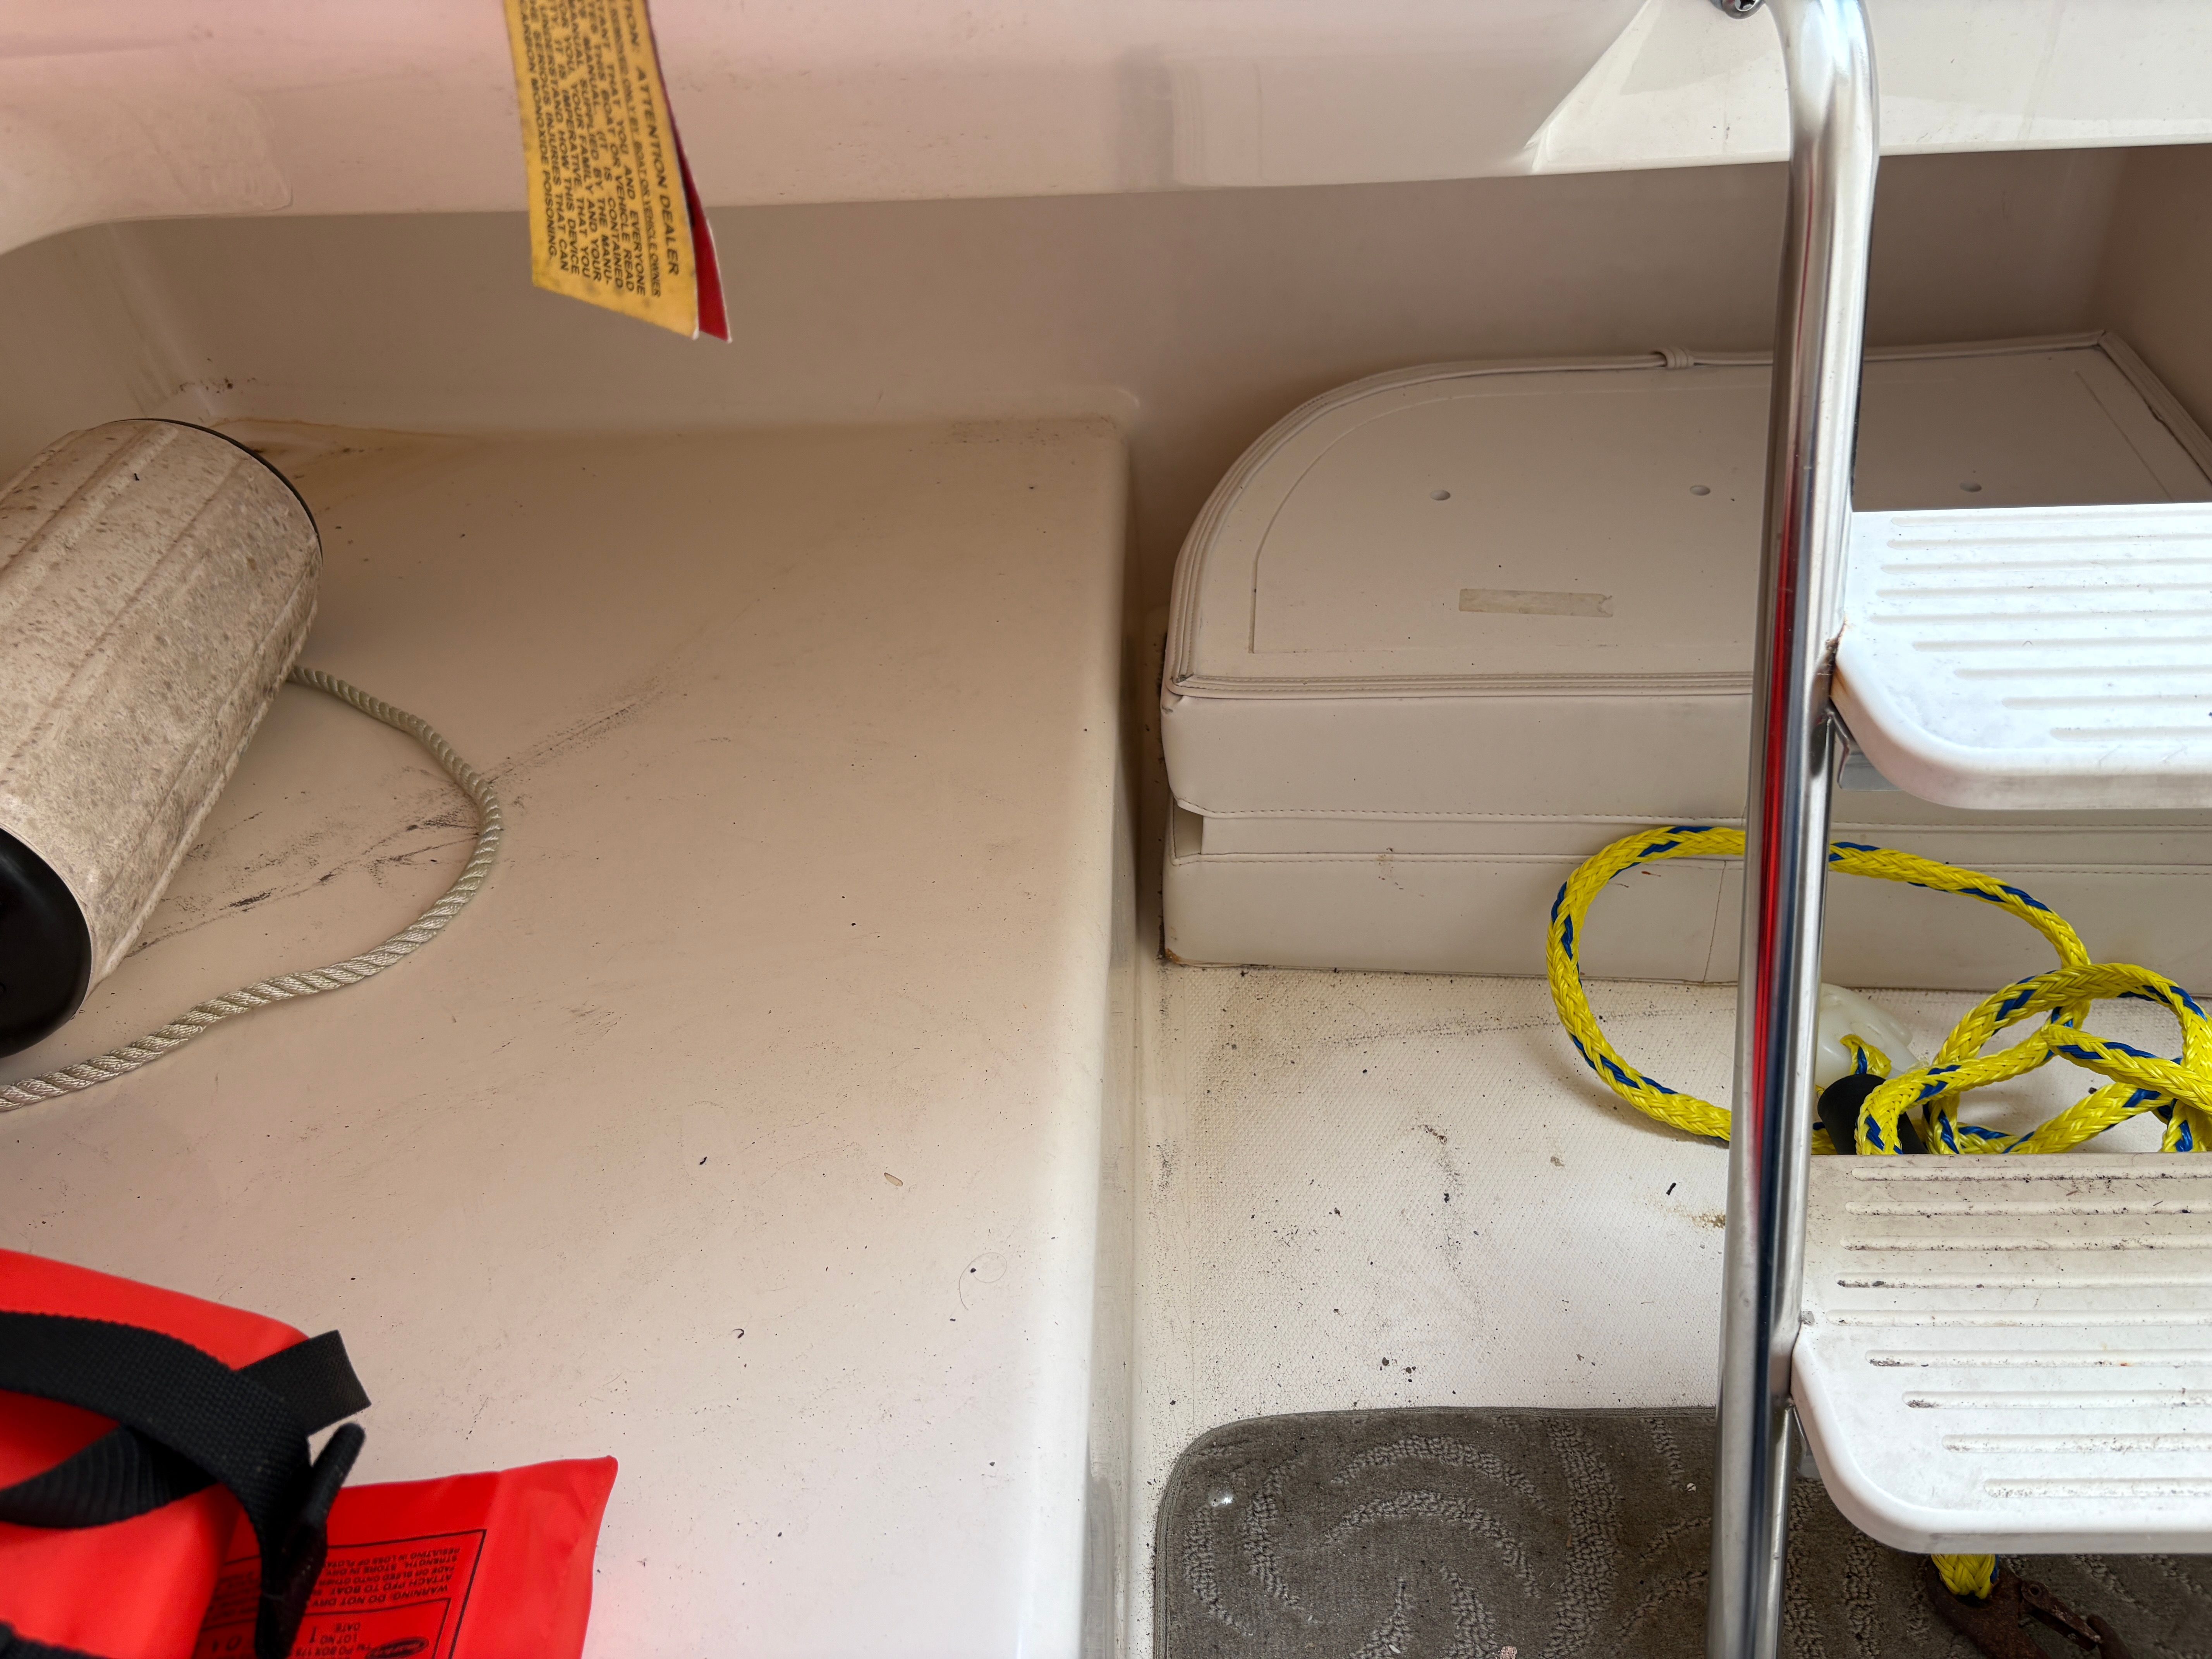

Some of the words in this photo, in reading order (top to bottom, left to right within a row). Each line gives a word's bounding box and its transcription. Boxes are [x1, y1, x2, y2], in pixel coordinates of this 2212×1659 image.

[532, 31, 551, 106] SERIOUS
[539, 5, 564, 123] UNDERSTAND
[593, 43, 606, 81] THIS
[606, 64, 621, 108] THAT
[570, 82, 584, 129] YOUR
[579, 79, 599, 160] SUPPLIED
[601, 89, 616, 135] BOAT
[544, 112, 562, 186] INJURIES
[557, 130, 570, 170] HOW
[561, 89, 582, 187] IMPERATIVE
[615, 118, 629, 154] YOU
[530, 77, 550, 166] MONOXIDE
[542, 170, 557, 261] POISONING.
[577, 134, 594, 195] FAMILY
[603, 166, 613, 182] IS
[609, 143, 621, 168] OR
[634, 141, 647, 179] BOAT
[635, 65, 668, 188] ATTENTION
[659, 195, 680, 275] DEALER
[563, 177, 575, 213] THIS
[592, 168, 603, 189] BY
[623, 165, 636, 199] AND
[554, 193, 566, 234] THAT
[575, 197, 587, 238] THAT
[586, 199, 598, 234] AND
[596, 197, 608, 227] THE
[615, 175, 630, 243] VEHICLE
[642, 199, 658, 251] VEHICLE
[558, 238, 568, 272] CAN
[567, 218, 580, 275] DEVICE
[579, 246, 591, 278] YOU
[590, 238, 602, 282] YOUR
[600, 234, 613, 285] MANU-
[607, 197, 624, 290] CONTAINED
[629, 210, 646, 297] EVERYONE
[622, 249, 635, 292] READ
[649, 253, 661, 297] OWNER
[362, 1563, 397, 1575] STORE
[371, 1554, 397, 1565] LOSS
[381, 1570, 413, 1582] BLEED
[328, 1585, 361, 1596] BOAT
[352, 1575, 381, 1585] ONTO
[362, 1584, 380, 1594] TO
[367, 1594, 386, 1604] DO
[381, 1580, 407, 1592] PFD
[407, 1573, 453, 1587] ATTACH
[310, 1597, 337, 1608] DRY
[339, 1595, 366, 1606] NOT
[333, 1621, 362, 1633] DATE
[335, 1633, 357, 1645] LOT
[313, 1645, 337, 1657] BOX
